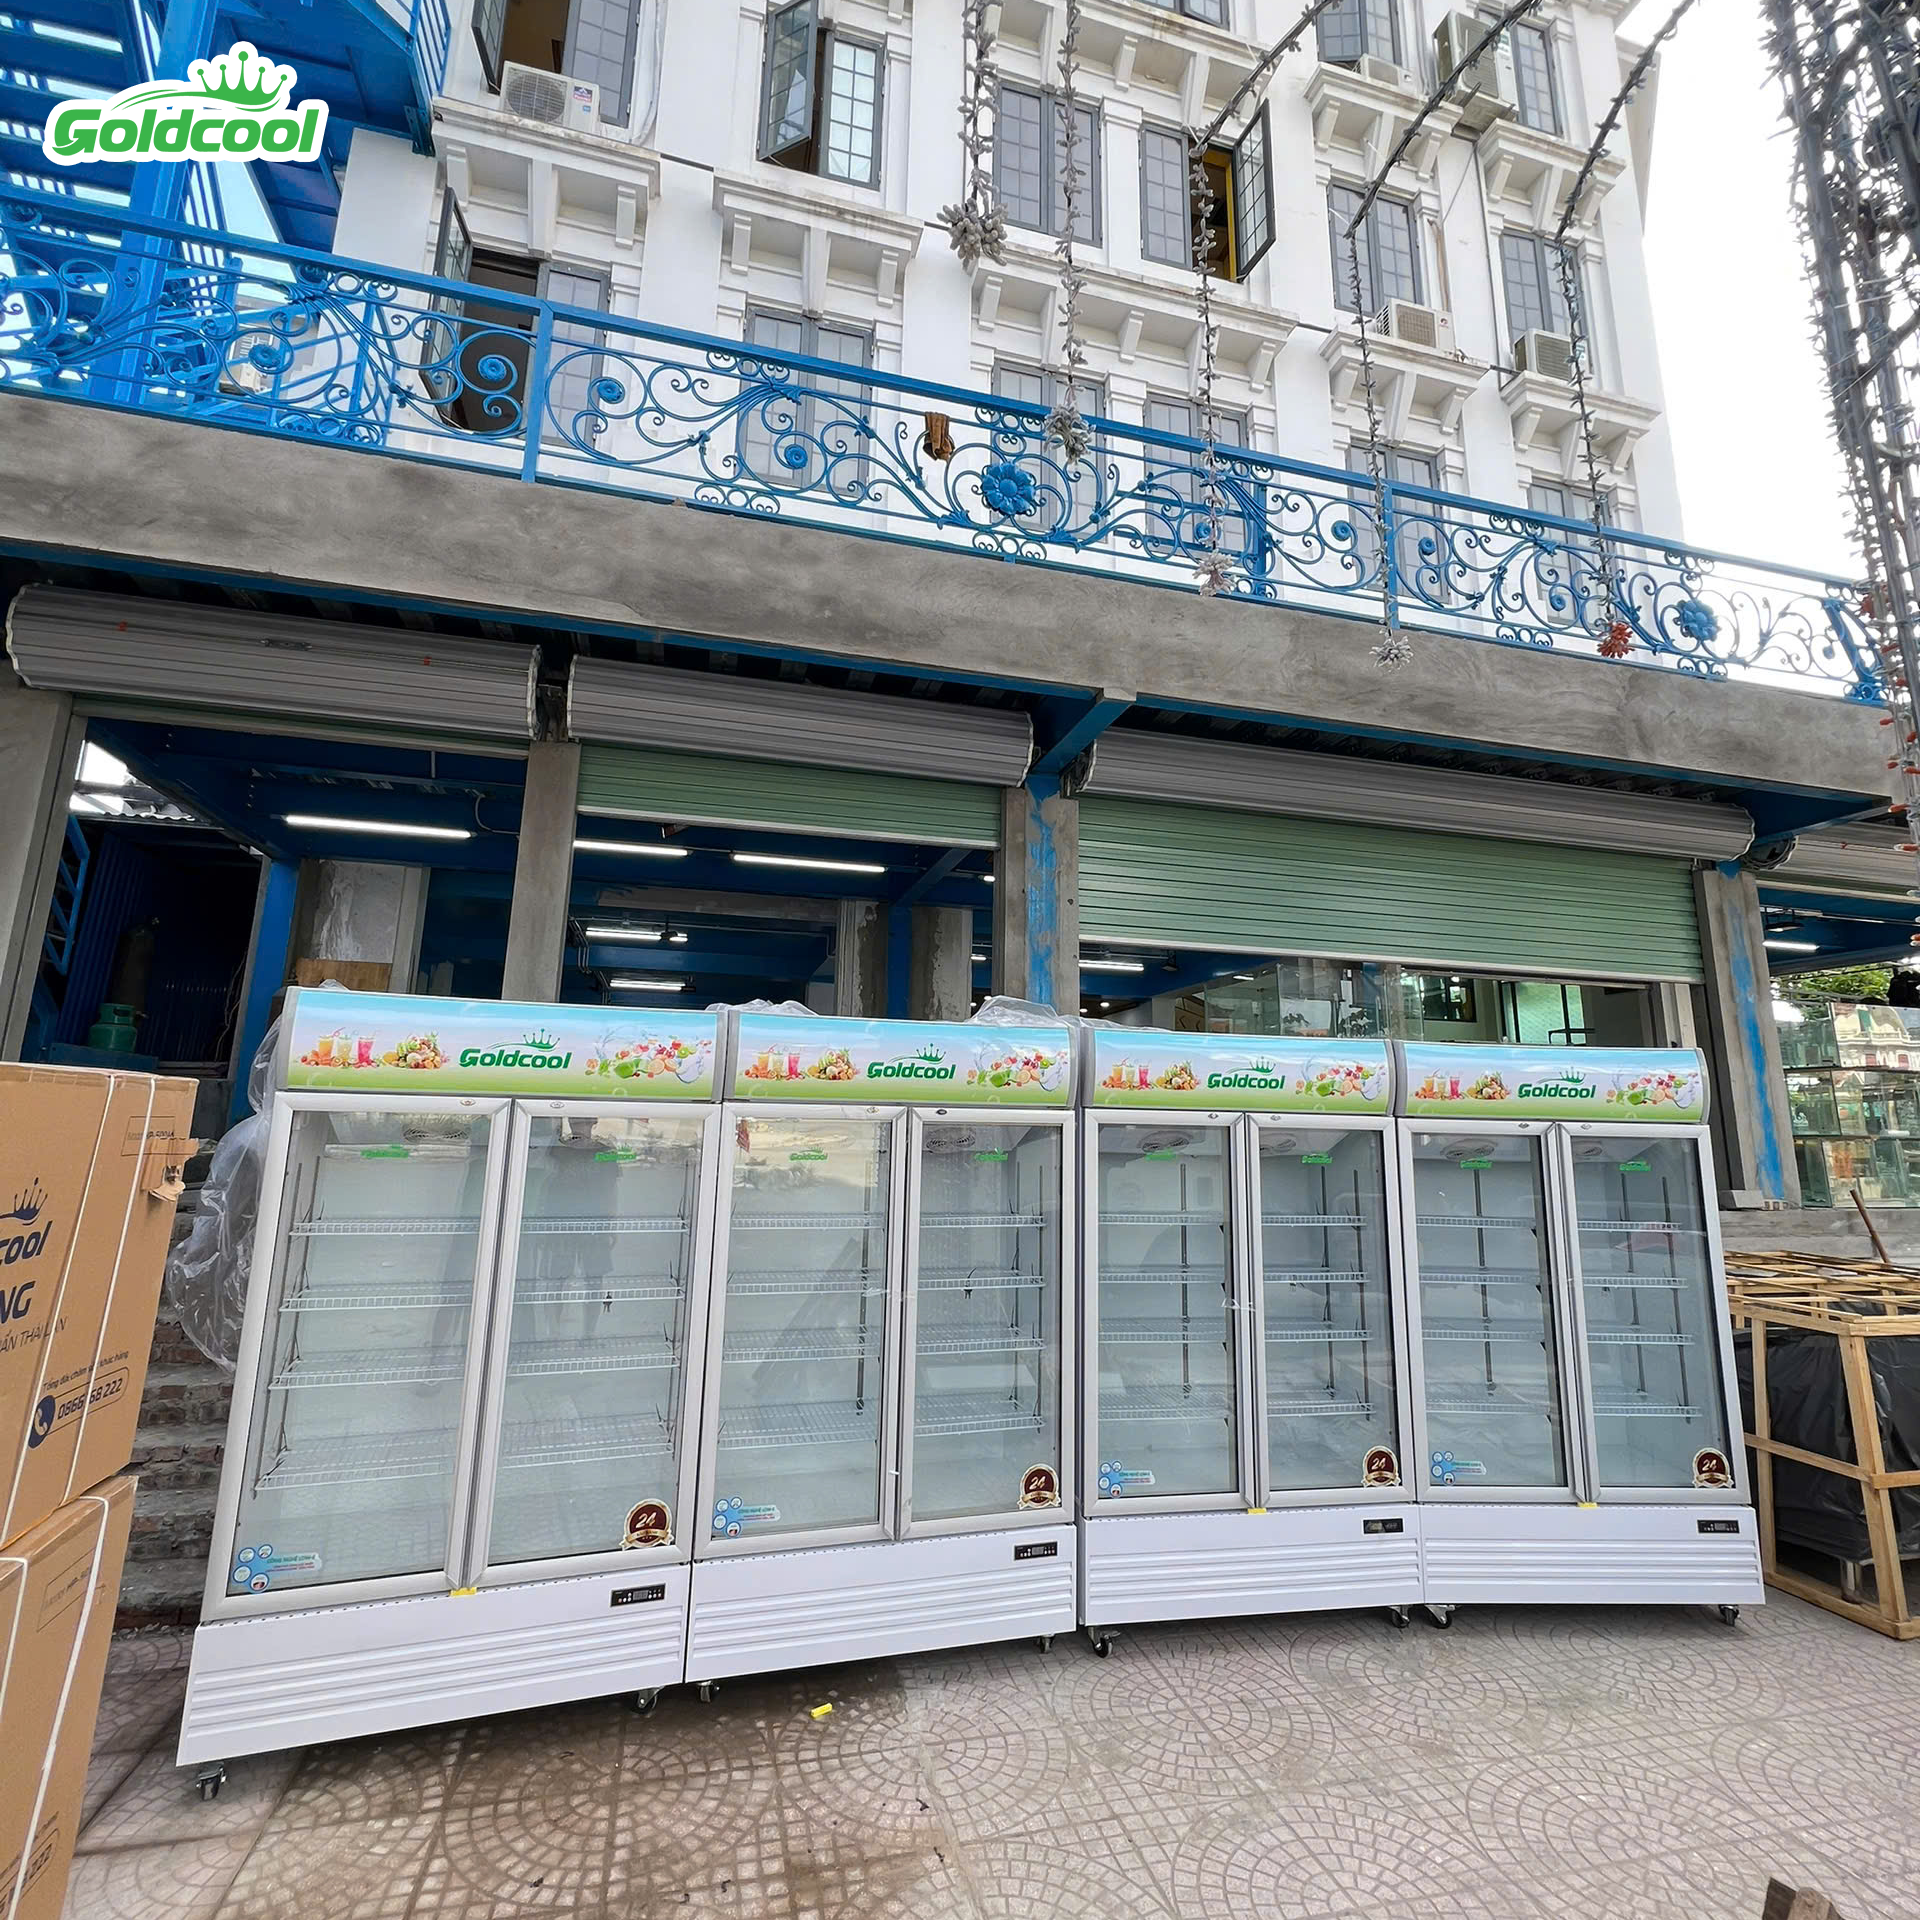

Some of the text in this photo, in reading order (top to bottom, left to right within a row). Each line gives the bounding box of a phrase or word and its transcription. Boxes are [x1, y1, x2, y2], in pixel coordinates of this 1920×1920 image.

[459, 1048, 572, 1068] Goldcool
[867, 1062, 956, 1079] Goldcool
[1208, 1073, 1285, 1089] Goldcool
[1518, 1083, 1596, 1098] Goldcool
[790, 1152, 828, 1161] Goldcool
[44, 1317, 67, 1338] LN
[103, 1378, 123, 1398] 222
[1371, 1457, 1386, 1470] 24
[1702, 1459, 1717, 1471] 24
[1029, 1476, 1046, 1490] 24
[635, 1511, 657, 1528] 24
